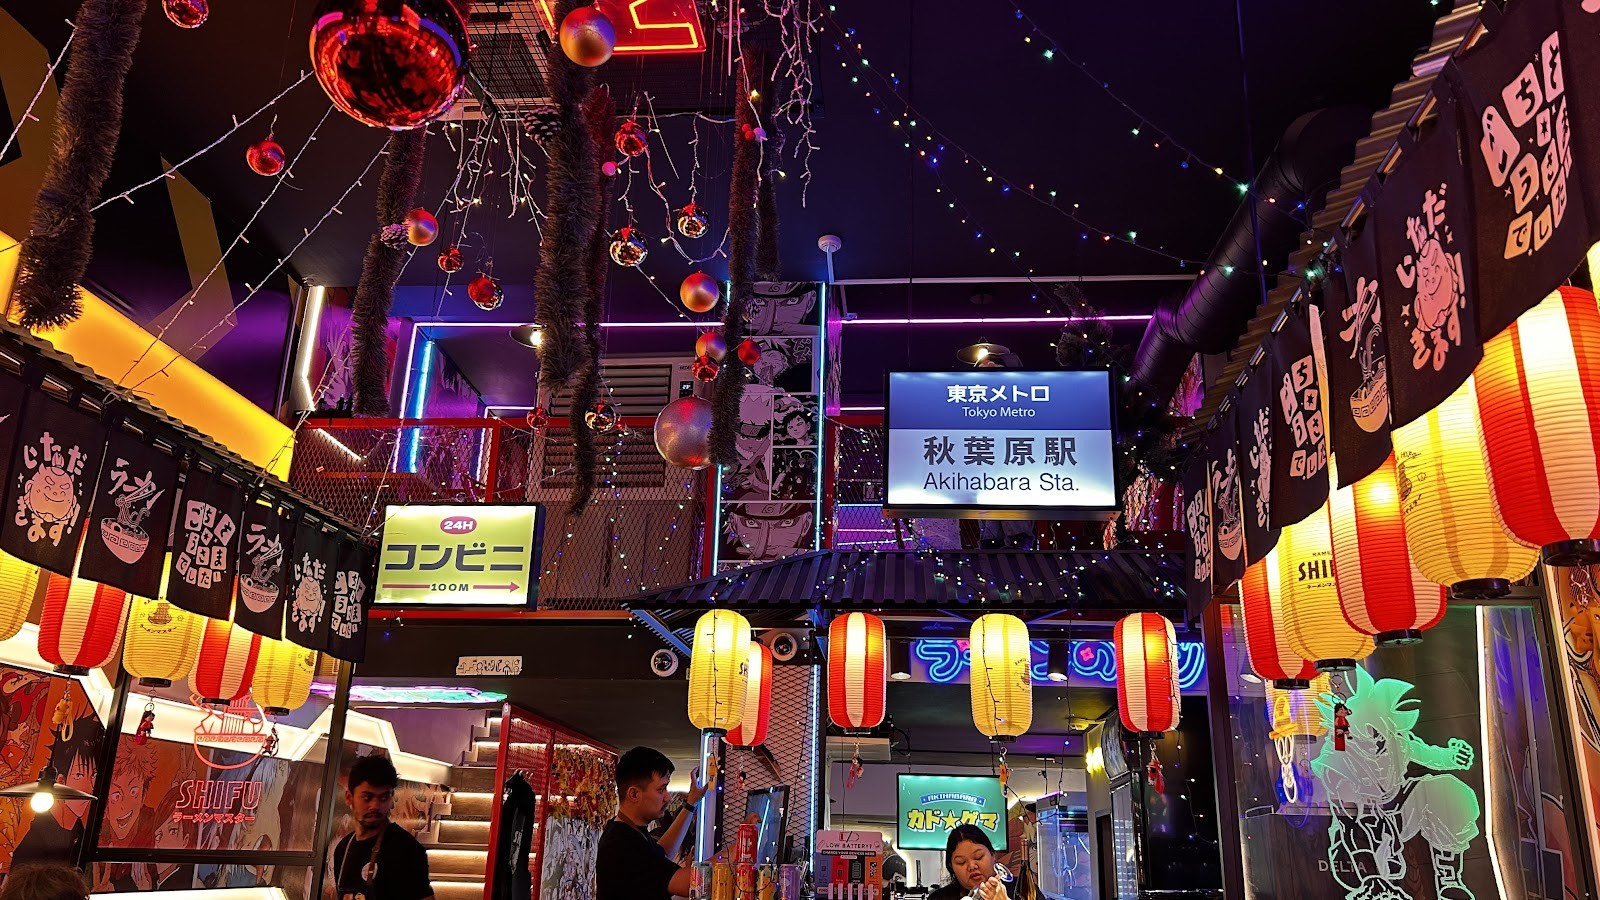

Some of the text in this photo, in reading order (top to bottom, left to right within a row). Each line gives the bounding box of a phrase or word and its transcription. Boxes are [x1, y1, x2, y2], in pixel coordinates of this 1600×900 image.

[947, 384, 1050, 403] 東京メトロ
[962, 406, 1035, 419] Tokyo Metro
[923, 436, 1078, 466] 秋葉原駅
[923, 472, 1079, 491] Akihabara Sta.
[444, 520, 474, 530] 24H
[385, 542, 524, 571] コンビニ
[431, 583, 469, 592] 100M
[175, 779, 262, 810] SHIFU
[928, 793, 977, 803] AKIHABARA
[172, 811, 256, 824] ラーメンマスター
[1318, 859, 1367, 873] DELTA
